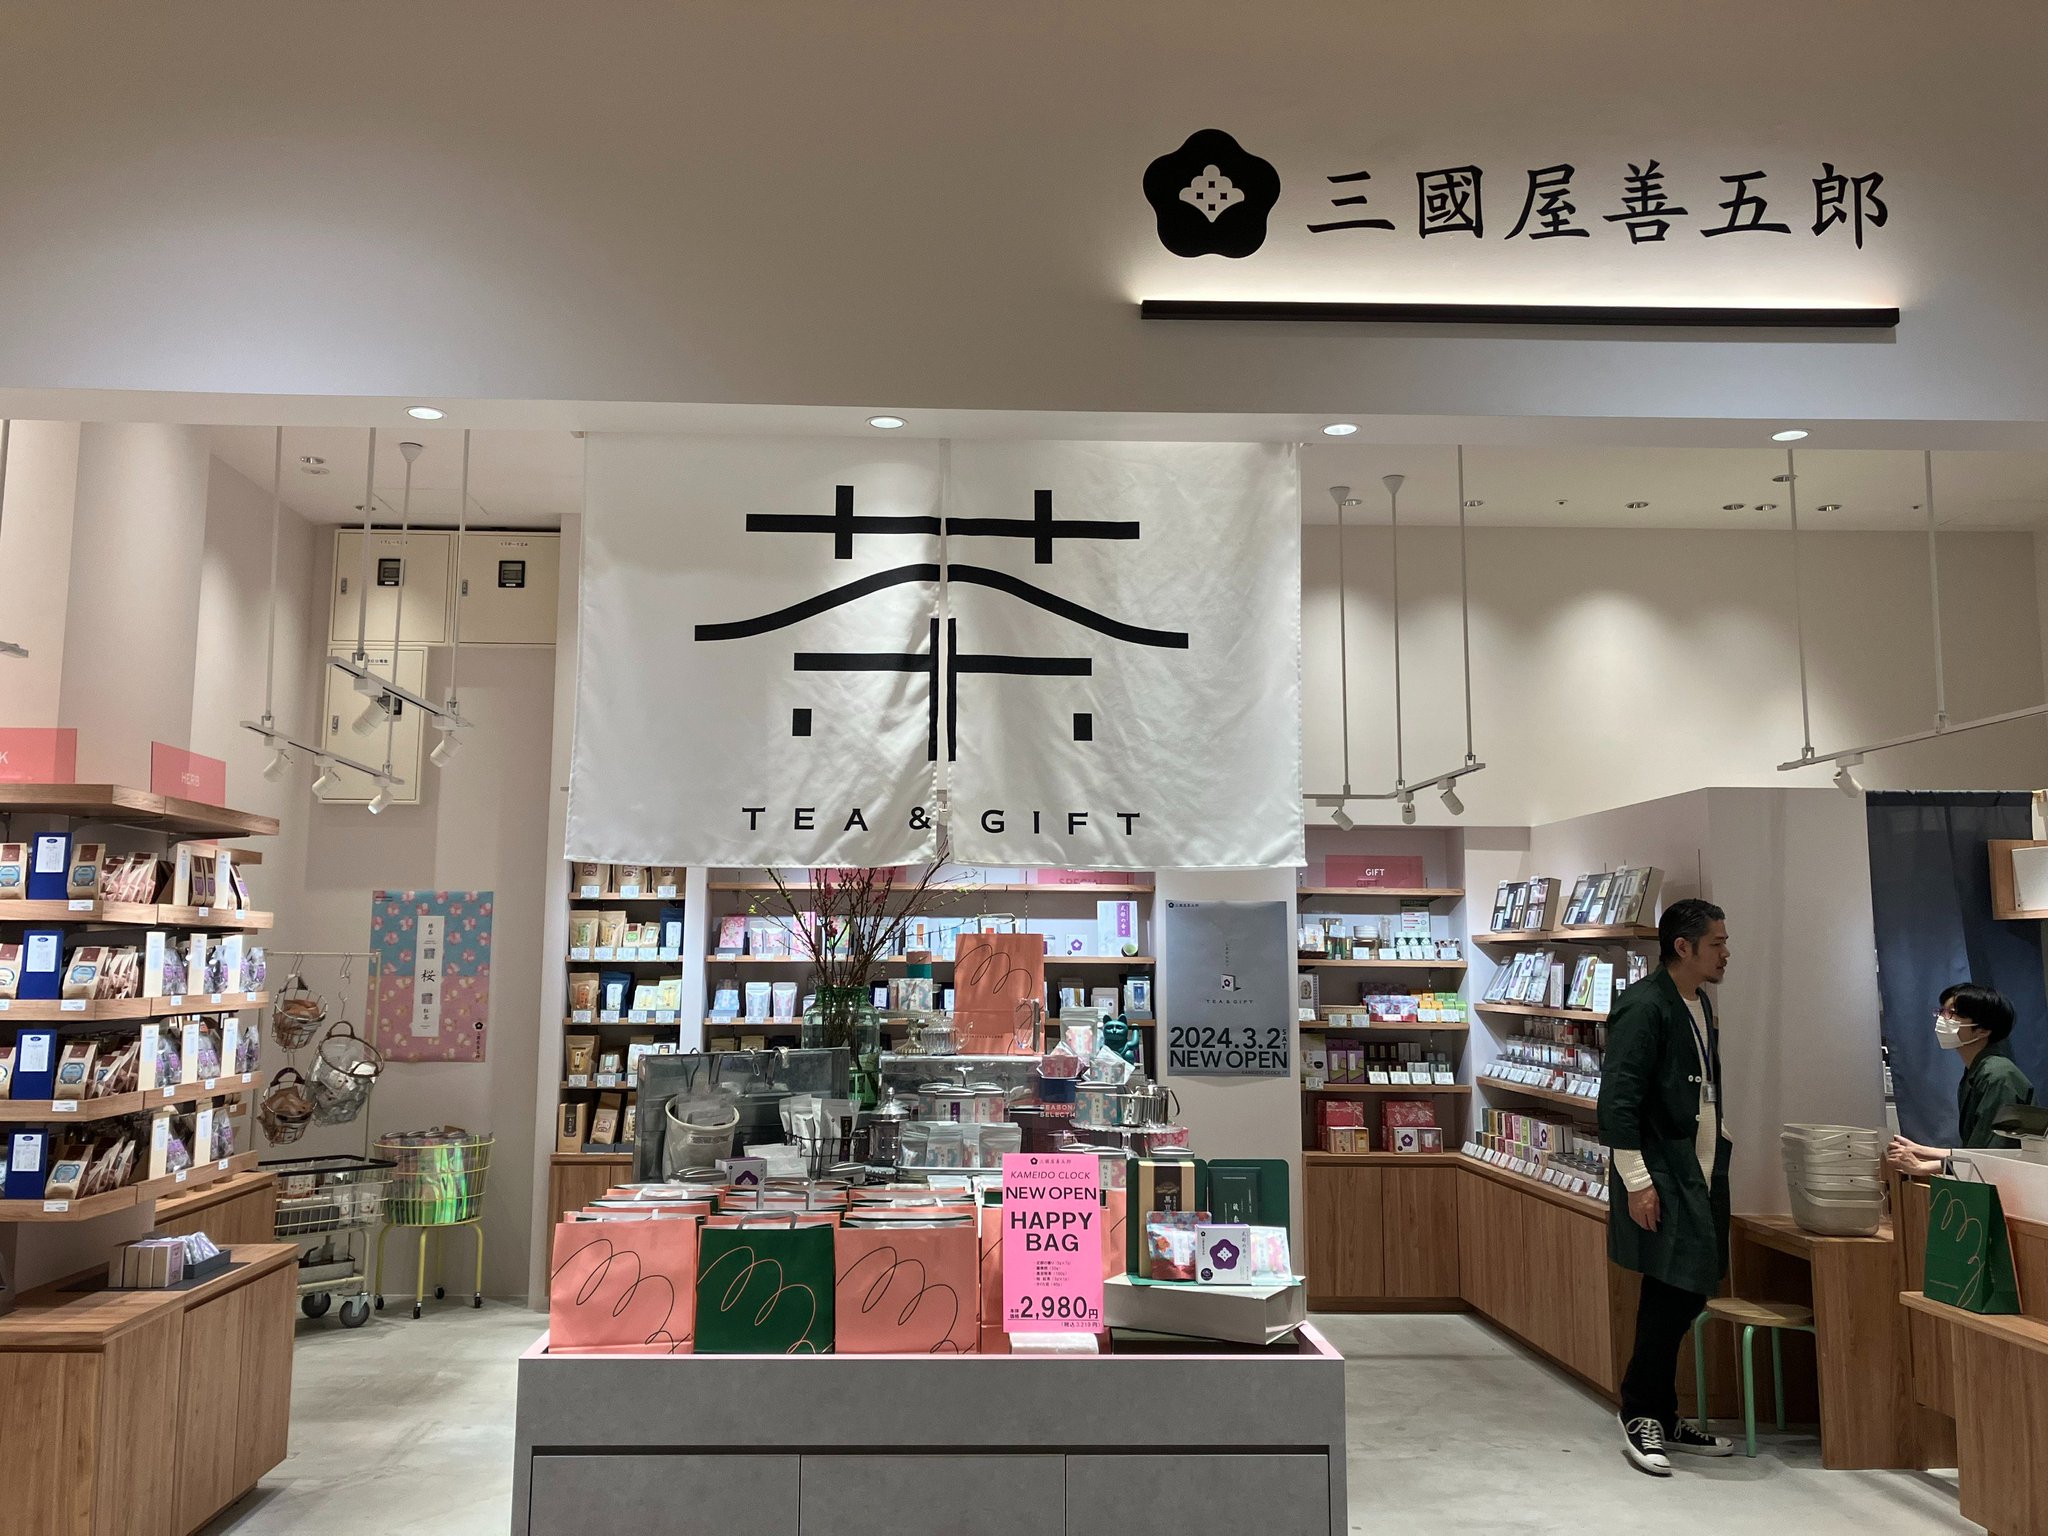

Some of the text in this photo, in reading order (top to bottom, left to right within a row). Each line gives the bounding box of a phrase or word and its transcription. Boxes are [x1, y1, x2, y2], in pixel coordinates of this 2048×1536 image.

[1306, 160, 1888, 250] 三國屋善五郎
[694, 485, 1189, 762] 茶
[742, 806, 1141, 836] TEA & GIFT
[1365, 868, 1385, 877] GIFT
[421, 969, 436, 983] 桜
[1169, 1026, 1281, 1049] 2024.3.2
[1169, 1050, 1222, 1068] NEW
[1225, 1050, 1288, 1069] OPEN
[1010, 1170, 1091, 1180] KAMEIDO CLOCK
[1005, 1186, 1097, 1200] NEW OPEN
[1010, 1211, 1093, 1230] HAPPY
[1026, 1233, 1079, 1252] BAG
